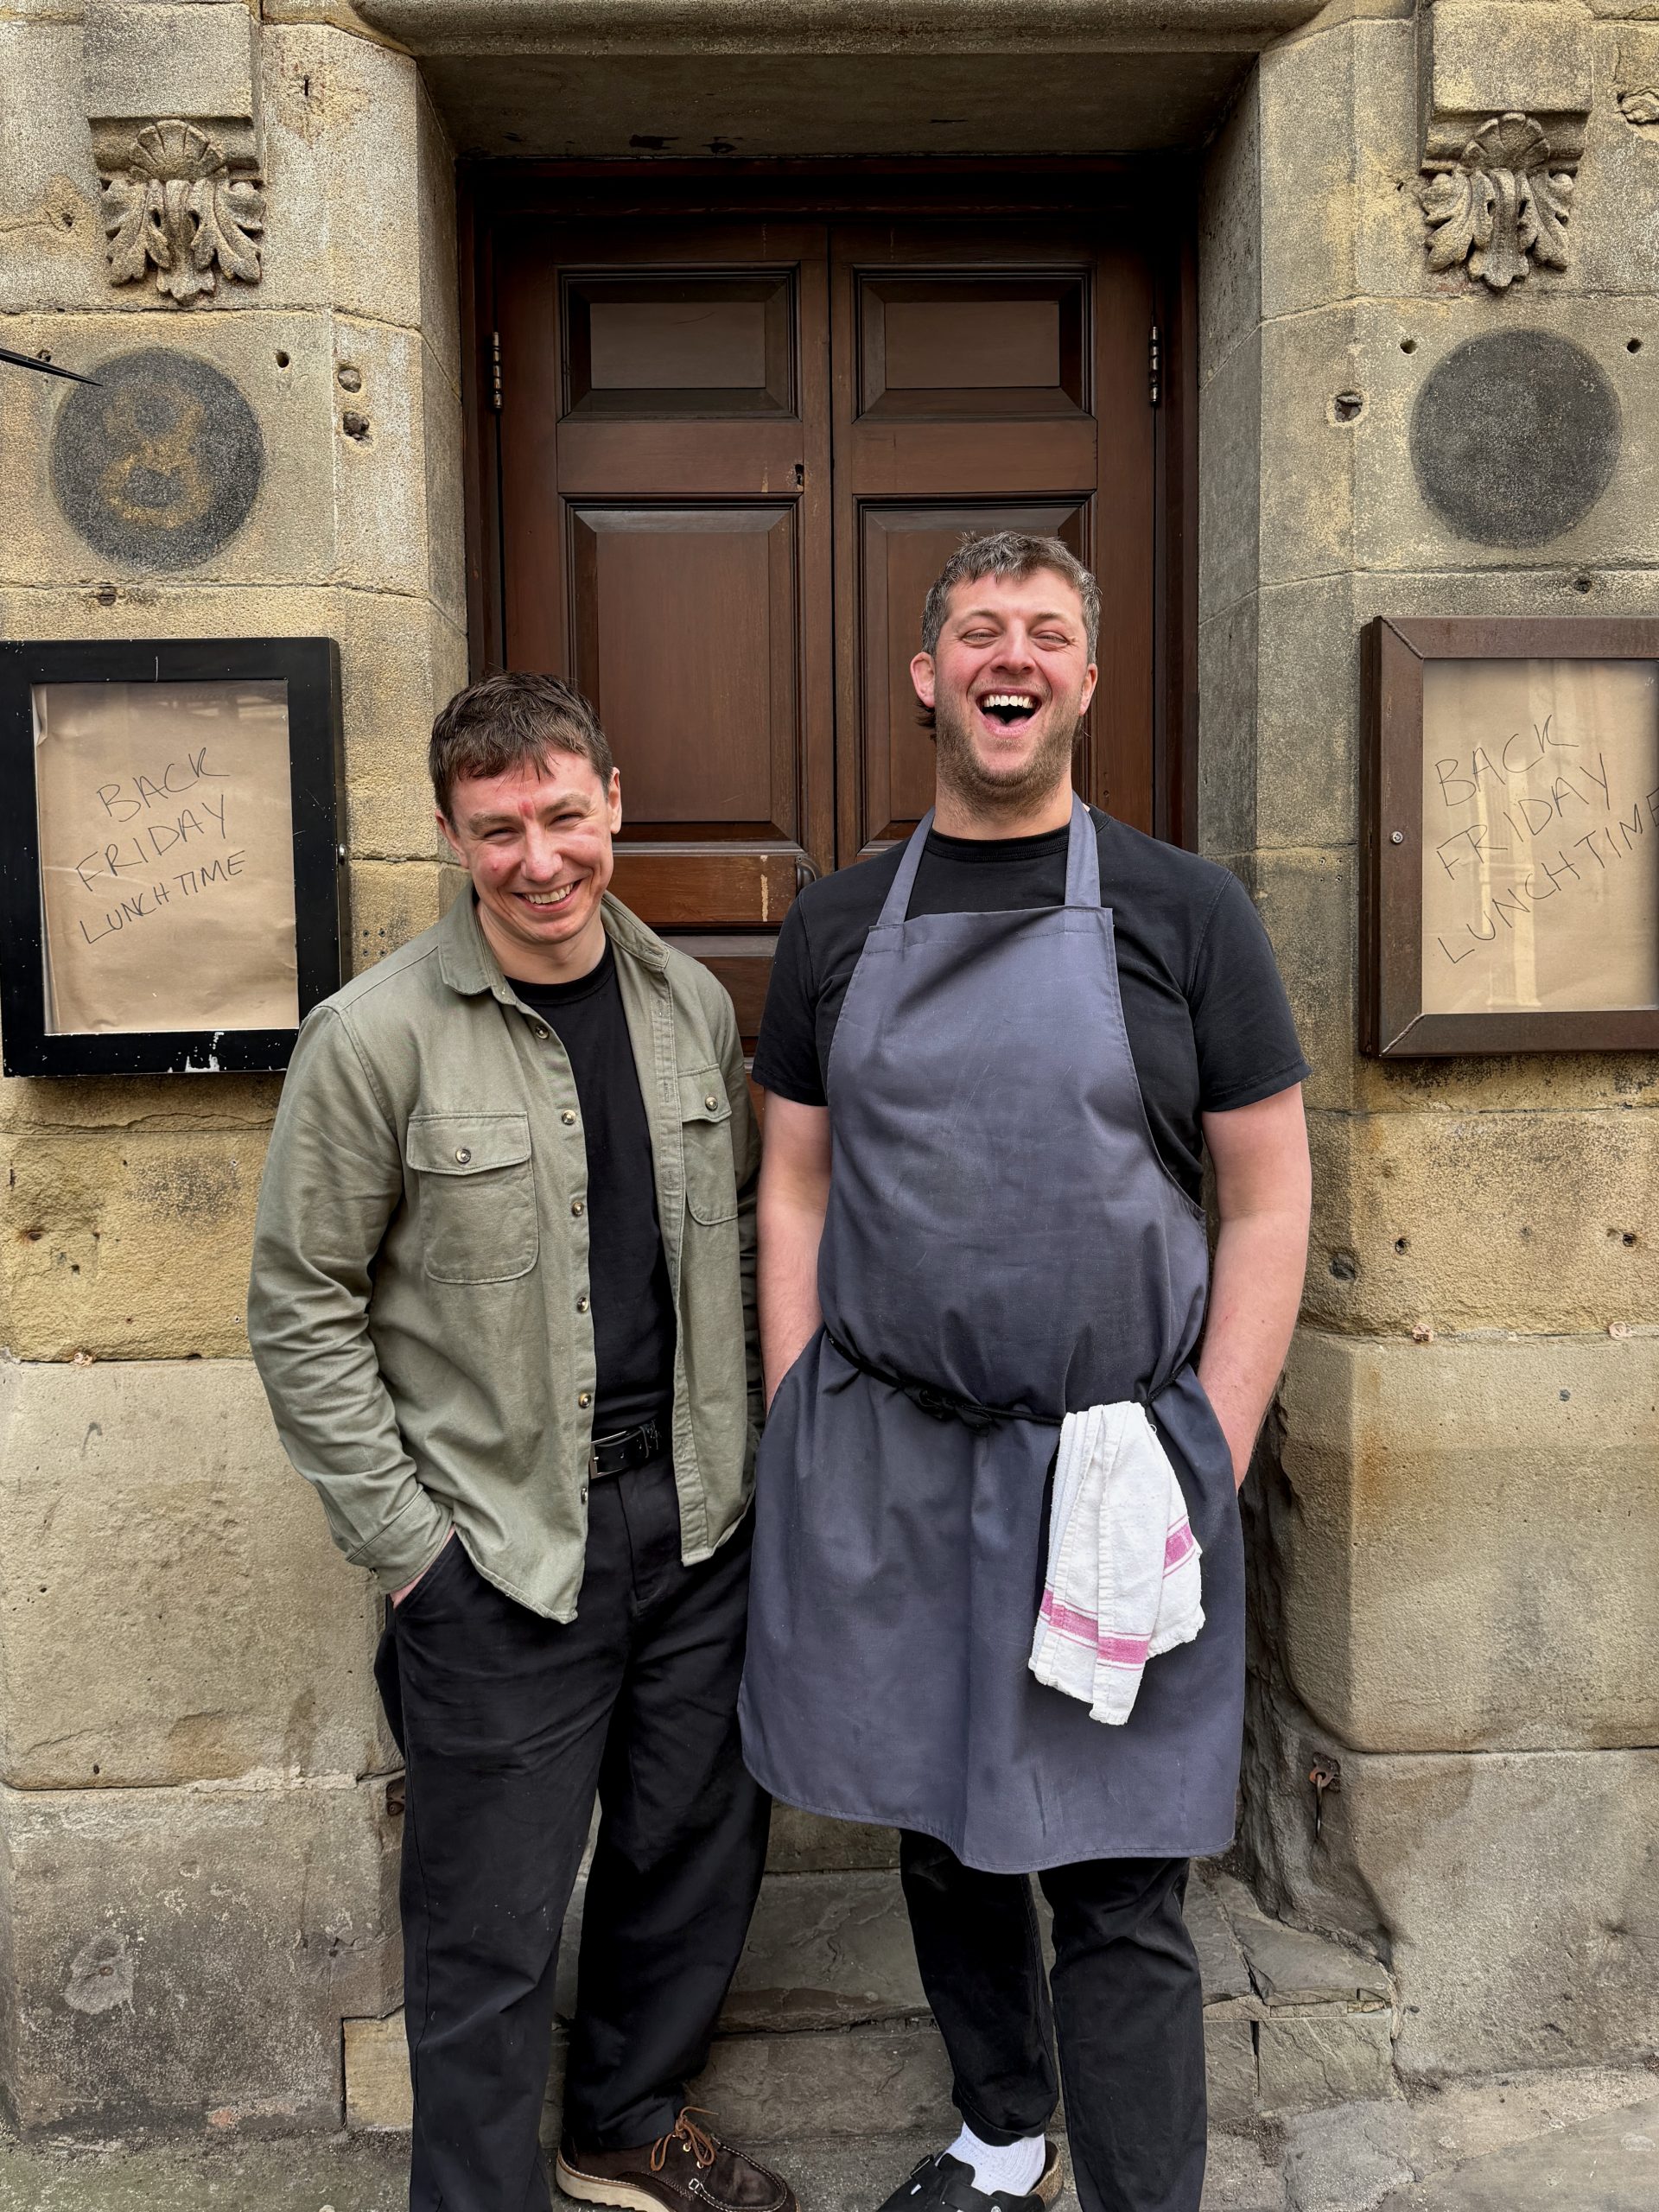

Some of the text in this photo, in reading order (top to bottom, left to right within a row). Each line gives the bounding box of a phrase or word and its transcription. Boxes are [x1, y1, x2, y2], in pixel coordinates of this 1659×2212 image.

[97, 747, 231, 823] BACK
[1436, 715, 1580, 806] BACK
[76, 794, 226, 892] FRIDAY
[1436, 753, 1611, 880] FRIDAY
